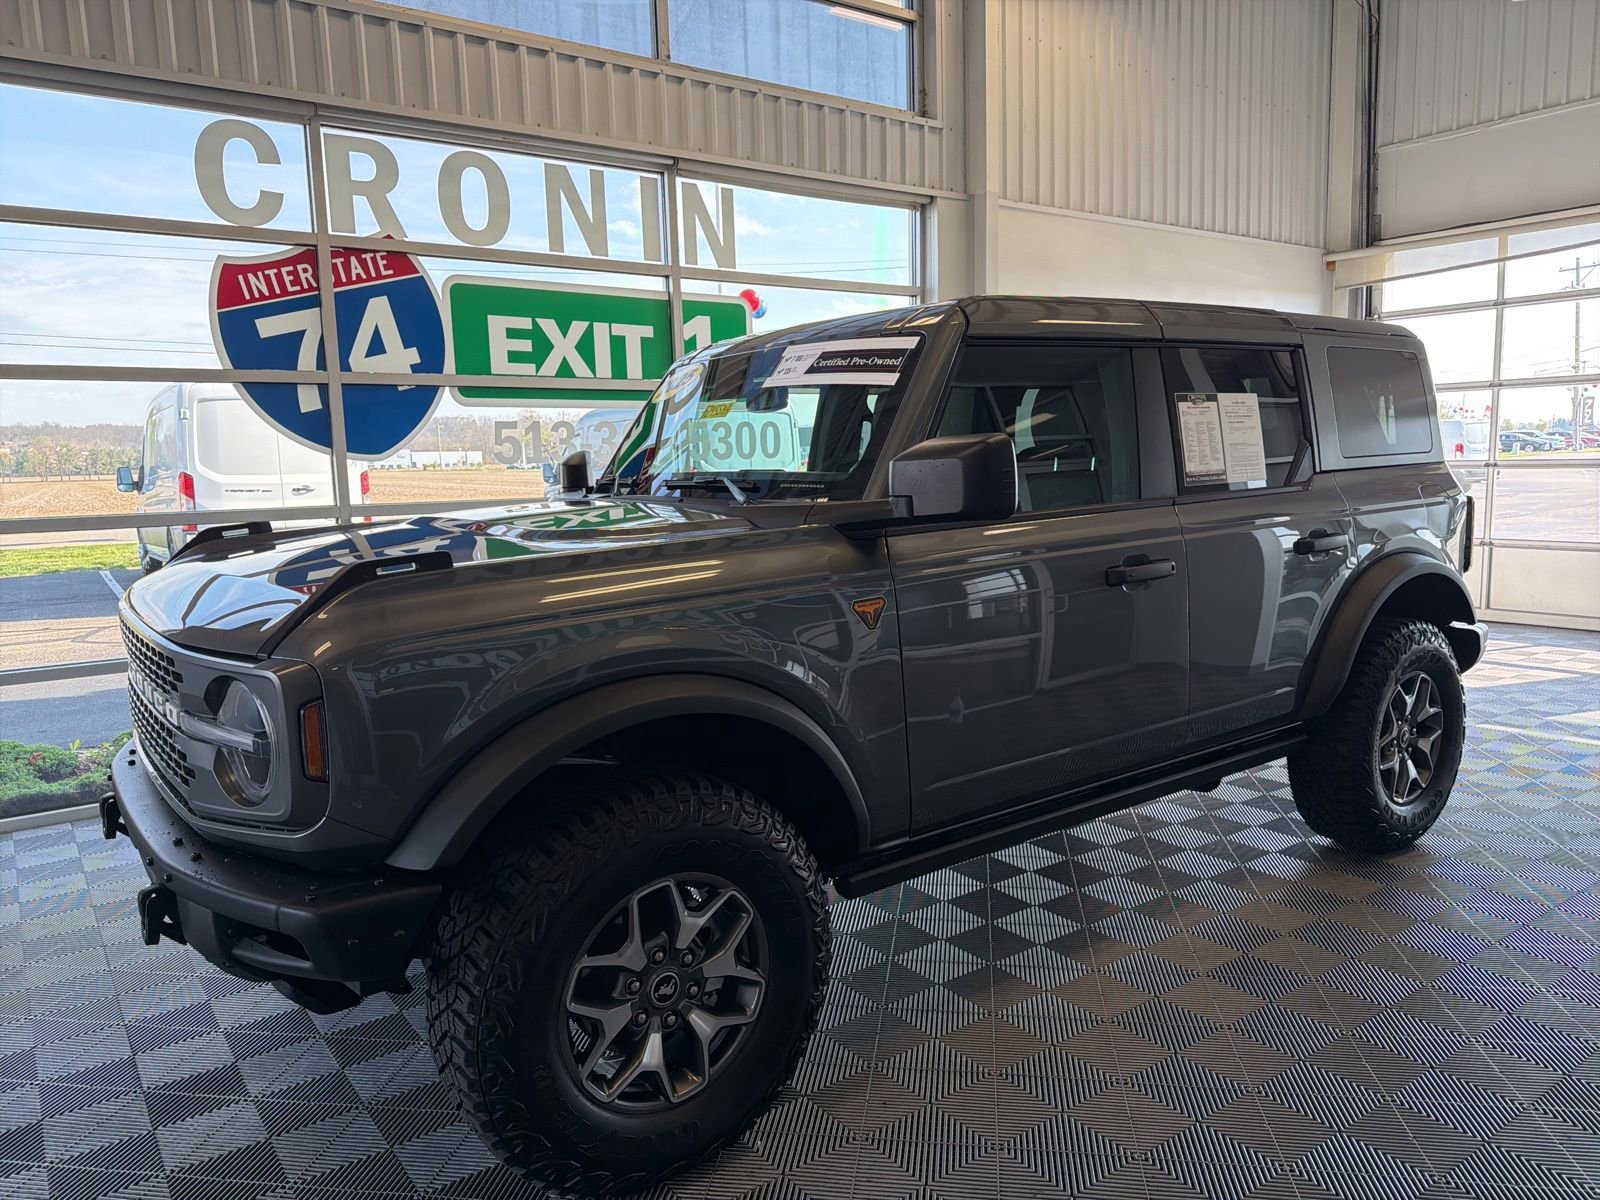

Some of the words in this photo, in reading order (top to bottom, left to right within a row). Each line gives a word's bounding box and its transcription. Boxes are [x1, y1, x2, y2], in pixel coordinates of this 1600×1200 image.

[194, 118, 736, 270] CRONIN
[238, 251, 394, 300] INTERTATE
[254, 295, 421, 414] 74
[487, 314, 654, 380] EXIT
[814, 357, 849, 367] Certified
[850, 356, 903, 366] Pre-Owned
